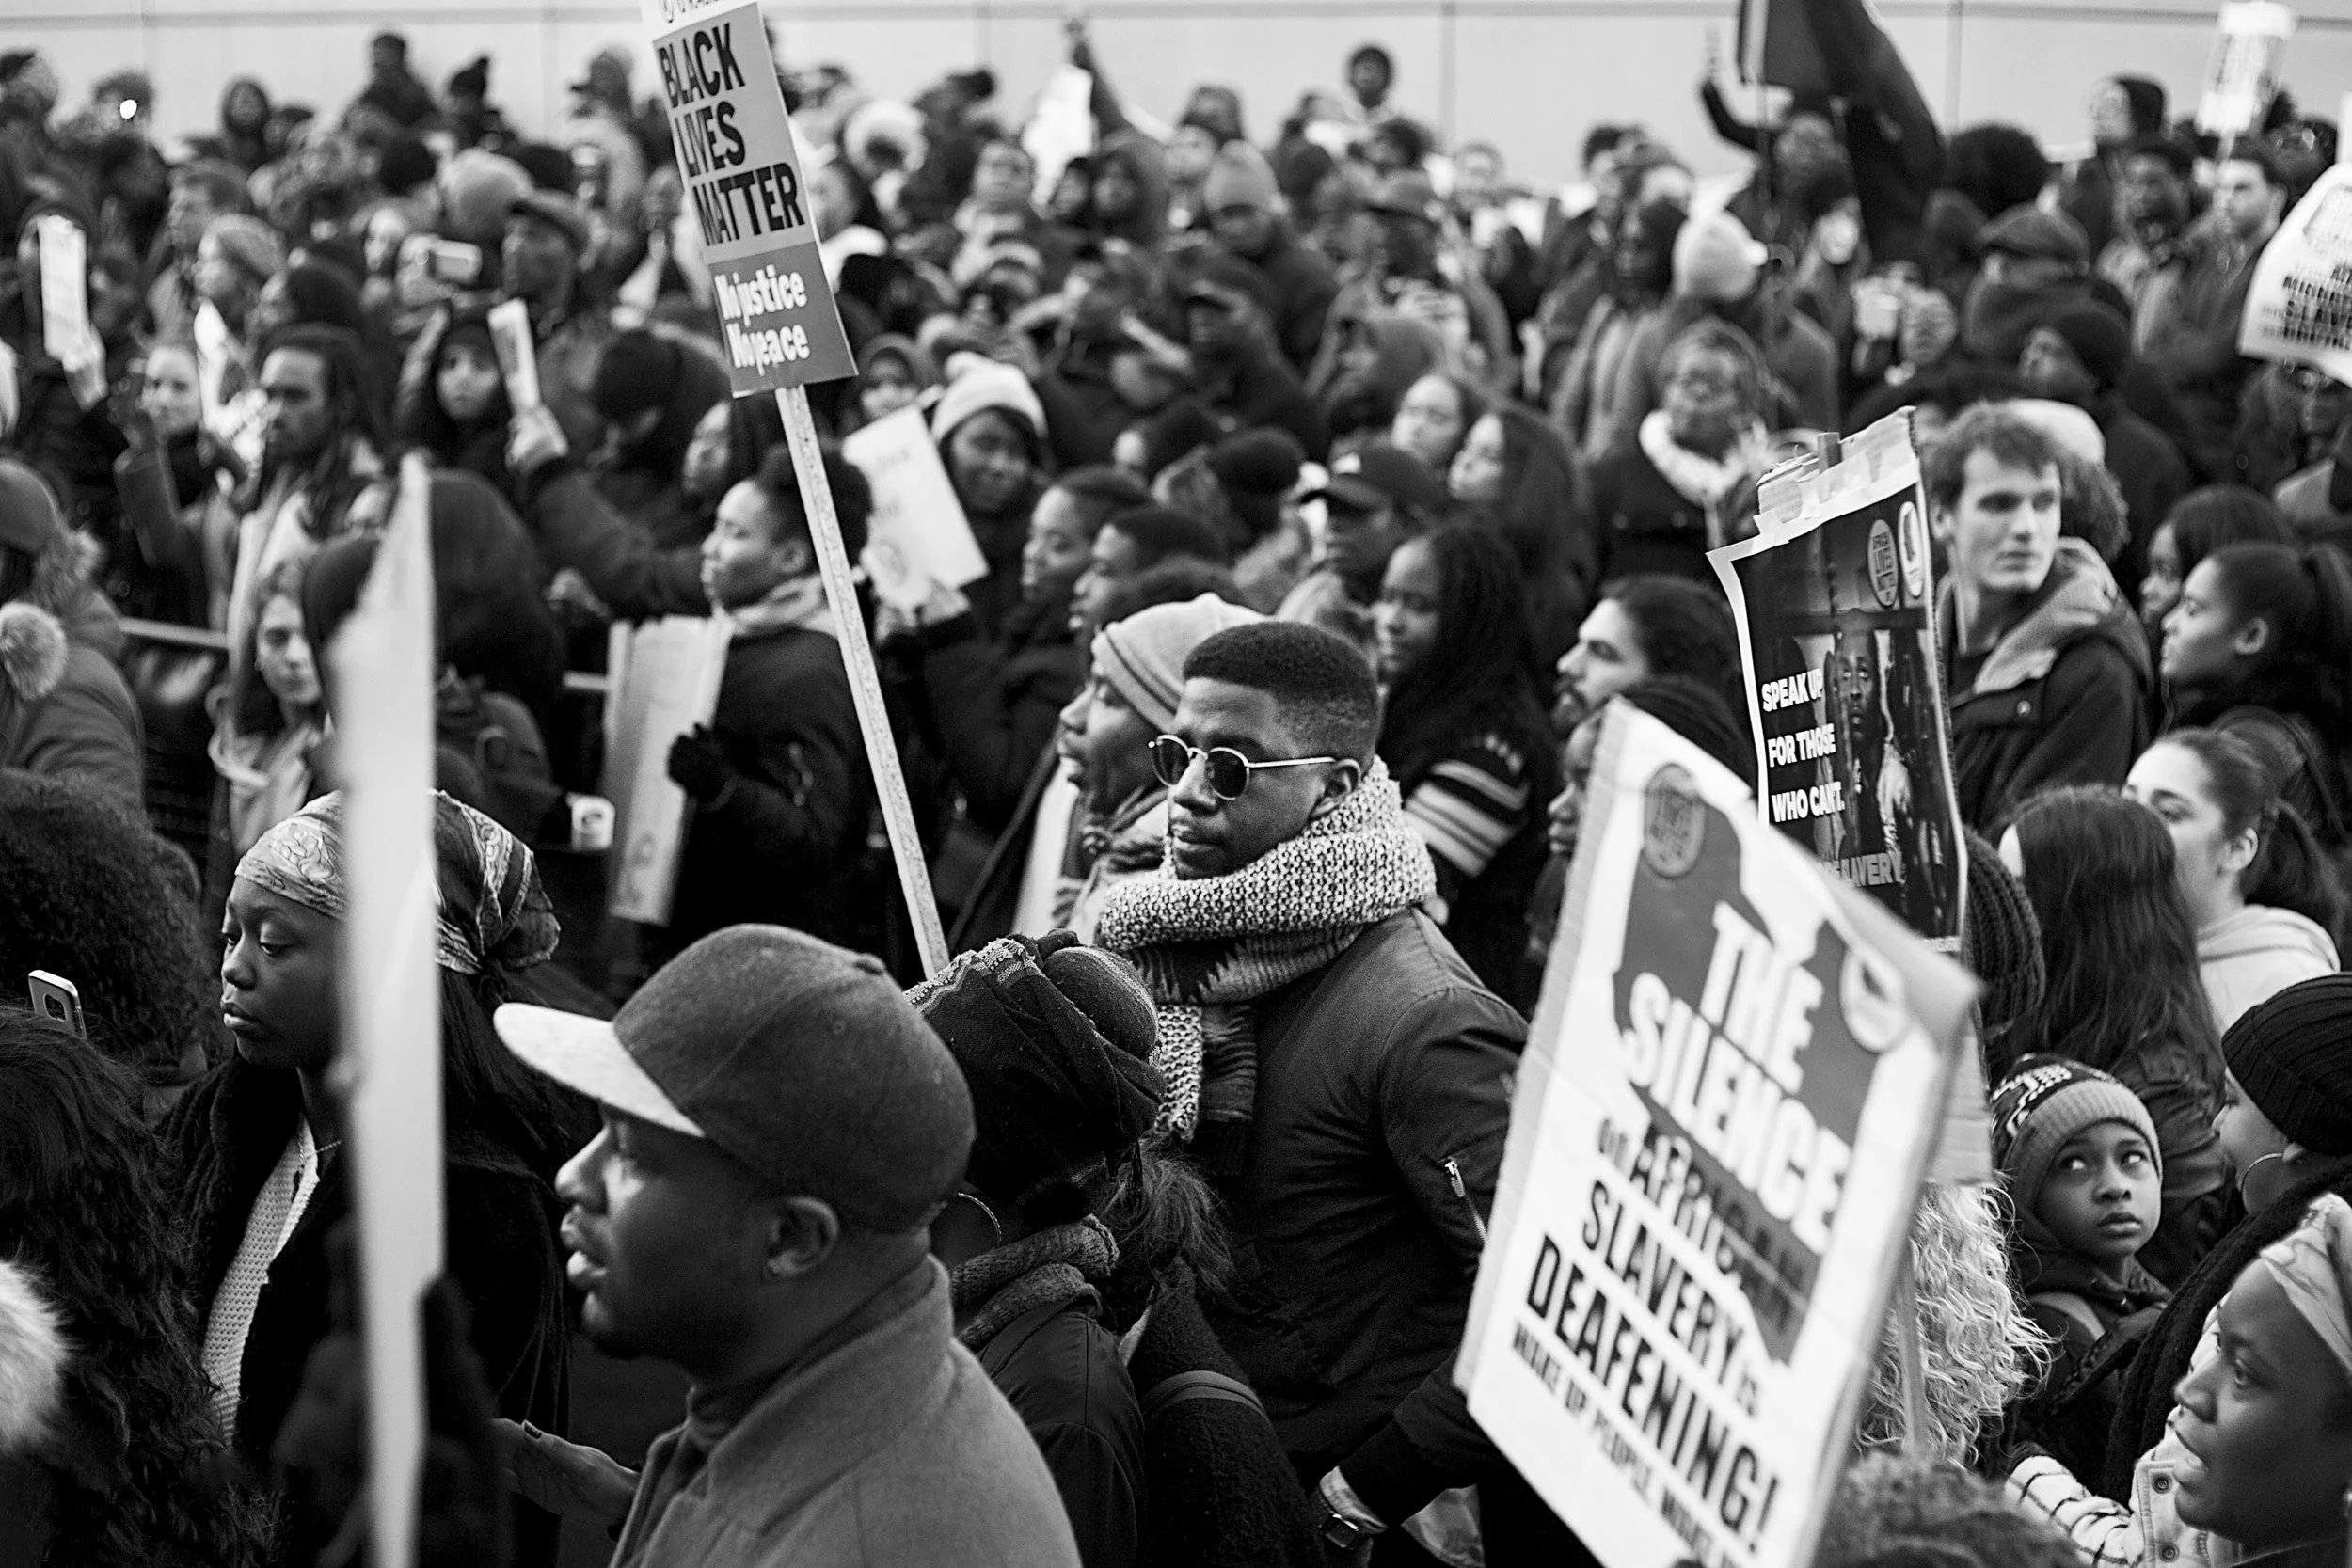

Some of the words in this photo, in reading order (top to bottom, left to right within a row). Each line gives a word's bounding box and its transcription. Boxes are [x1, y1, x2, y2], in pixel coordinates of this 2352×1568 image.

[659, 22, 745, 108] BLACK
[675, 101, 745, 178] LIVES
[692, 162, 805, 246] MATTER
[1761, 672, 1810, 712] SPEAK
[1807, 668, 1823, 700] UP
[1767, 734, 1797, 768] FOR
[1795, 723, 1836, 761] THOSE
[1771, 788, 1808, 823] WHO
[1699, 900, 1824, 1094] THE
[1621, 972, 1853, 1256] SILENCE
[1582, 1180, 1744, 1385] SLAVERY
[1527, 1234, 1779, 1554] DEAFENING!
